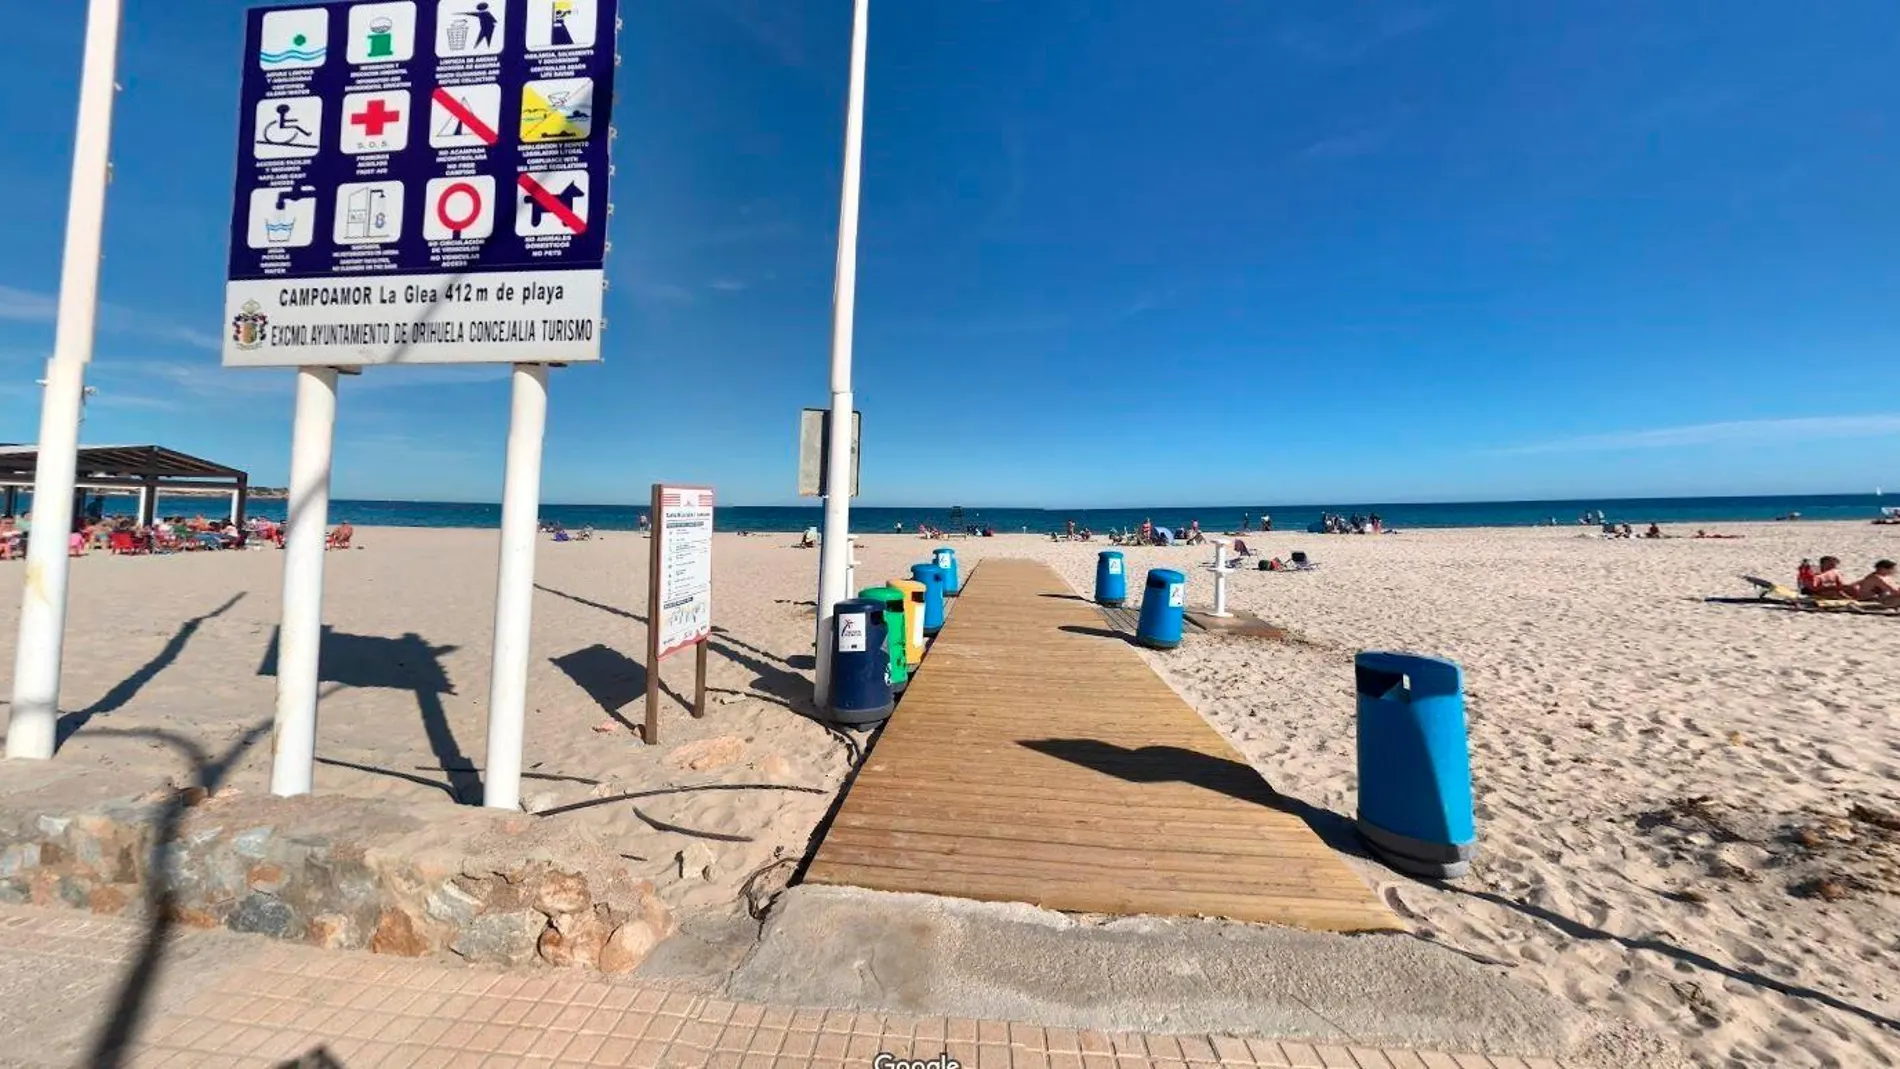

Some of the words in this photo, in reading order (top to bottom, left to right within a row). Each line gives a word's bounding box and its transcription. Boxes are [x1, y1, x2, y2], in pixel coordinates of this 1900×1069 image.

[279, 286, 372, 307] CAMPOAMOR
[380, 284, 397, 304] La
[404, 284, 438, 304] Glea
[496, 281, 514, 301] de
[522, 281, 564, 305] playa
[395, 321, 408, 344] DE
[411, 320, 465, 344] ORIHUELA
[469, 319, 536, 343] CONCEJALIA
[542, 317, 593, 341] TURISMO
